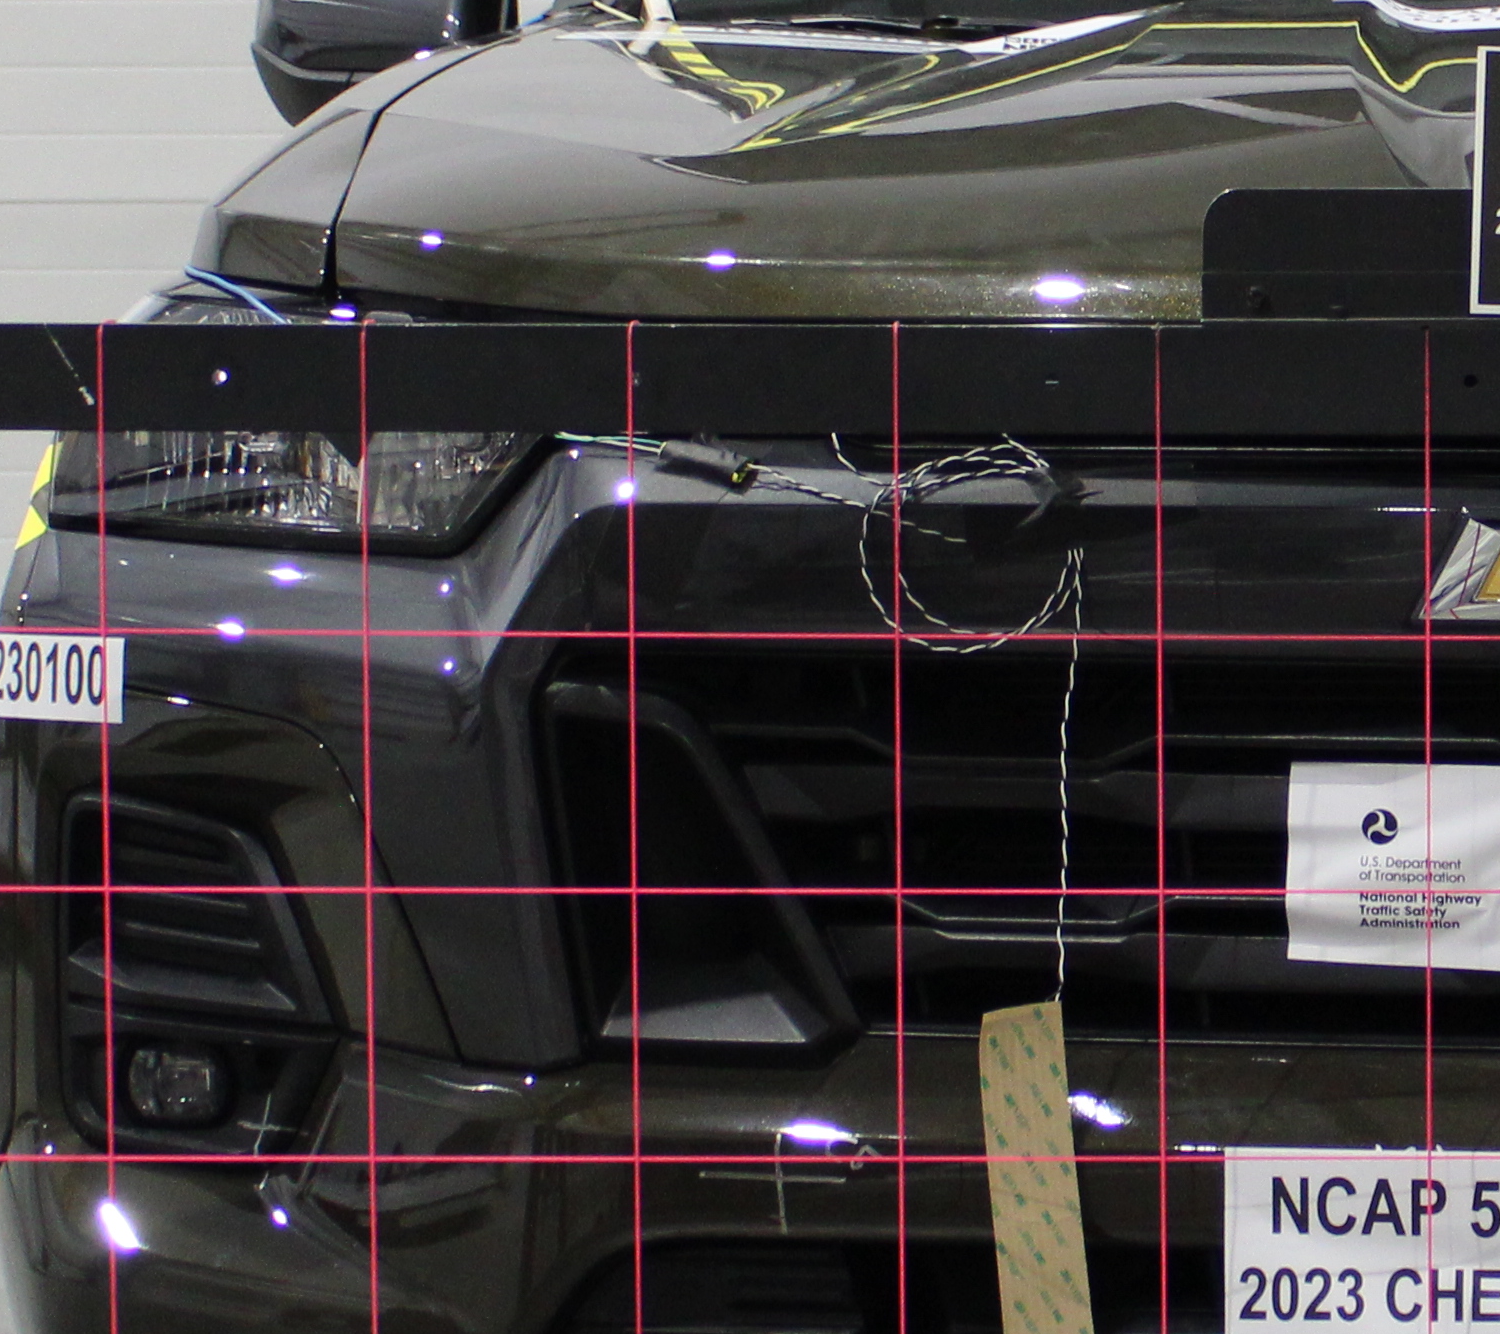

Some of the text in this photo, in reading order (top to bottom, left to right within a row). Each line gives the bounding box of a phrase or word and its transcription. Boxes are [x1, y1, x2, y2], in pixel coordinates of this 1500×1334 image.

[1360, 855, 1462, 870] U.S. Department
[1359, 870, 1466, 883] of Transportation
[1359, 892, 1417, 903] National
[1359, 905, 1400, 916] Traffic
[1271, 1177, 1447, 1238] NCAP
[1239, 1267, 1366, 1323] 2023
